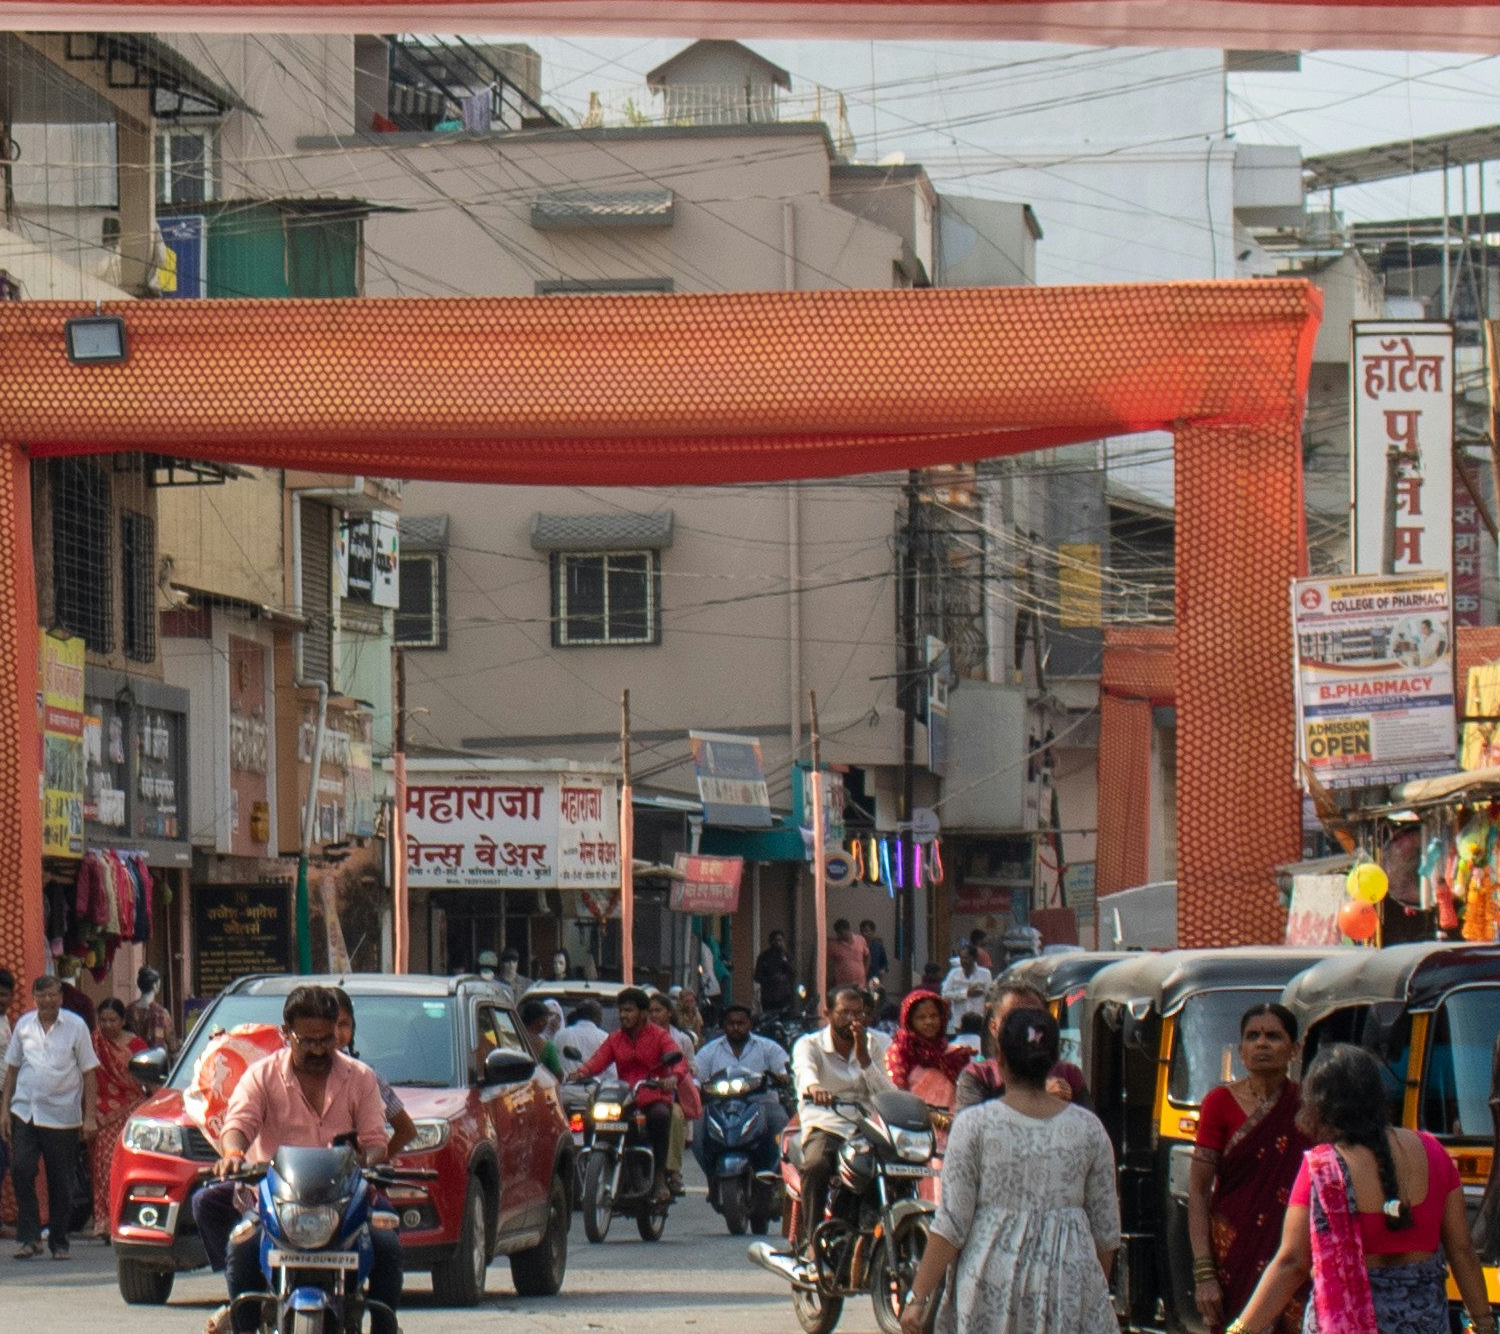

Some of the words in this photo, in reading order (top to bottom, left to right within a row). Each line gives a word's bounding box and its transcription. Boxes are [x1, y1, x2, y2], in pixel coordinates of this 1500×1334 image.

[1362, 337, 1446, 402] हॉटेल
[1331, 597, 1374, 613] COLLEGE
[1377, 597, 1390, 610] OF
[1392, 592, 1447, 609] PHARMACY
[1319, 677, 1433, 700] B.PHARMACY
[1308, 722, 1370, 738] ADMISSION
[1310, 734, 1370, 757] OPEN
[405, 786, 545, 824] महाराजा
[560, 786, 603, 825] महाराजा
[474, 834, 548, 868] वेअर
